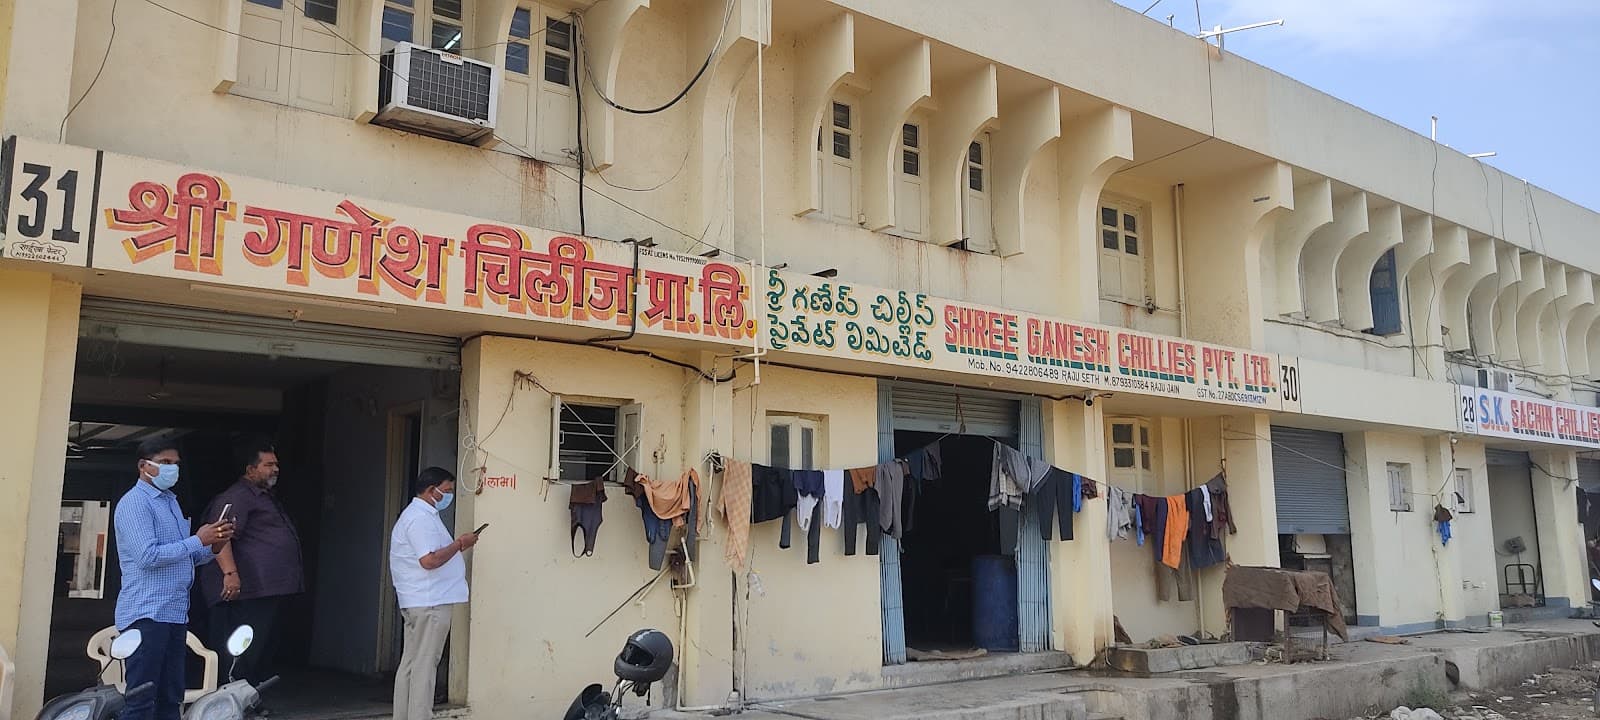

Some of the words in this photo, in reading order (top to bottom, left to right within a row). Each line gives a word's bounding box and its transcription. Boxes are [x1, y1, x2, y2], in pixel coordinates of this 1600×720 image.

[18, 163, 79, 243] 31
[105, 173, 236, 274] श्री
[243, 199, 453, 304] गणेश
[944, 305, 1018, 360] SHREE
[1026, 317, 1111, 373] GANESH
[1117, 332, 1196, 384] CHILLIES
[968, 358, 988, 371] Mob.
[989, 360, 1004, 373] No.
[1005, 362, 1059, 380] 9422806489
[1061, 370, 1080, 383] RAJU
[1081, 372, 1100, 385] SETH
[1150, 381, 1166, 392] RAJU
[1167, 383, 1180, 394] JAIN
[1197, 388, 1207, 398] GST
[1282, 365, 1298, 402] 30
[1462, 396, 1475, 423] 28
[1479, 394, 1510, 432] S.K.
[1510, 399, 1555, 438] SACHIN
